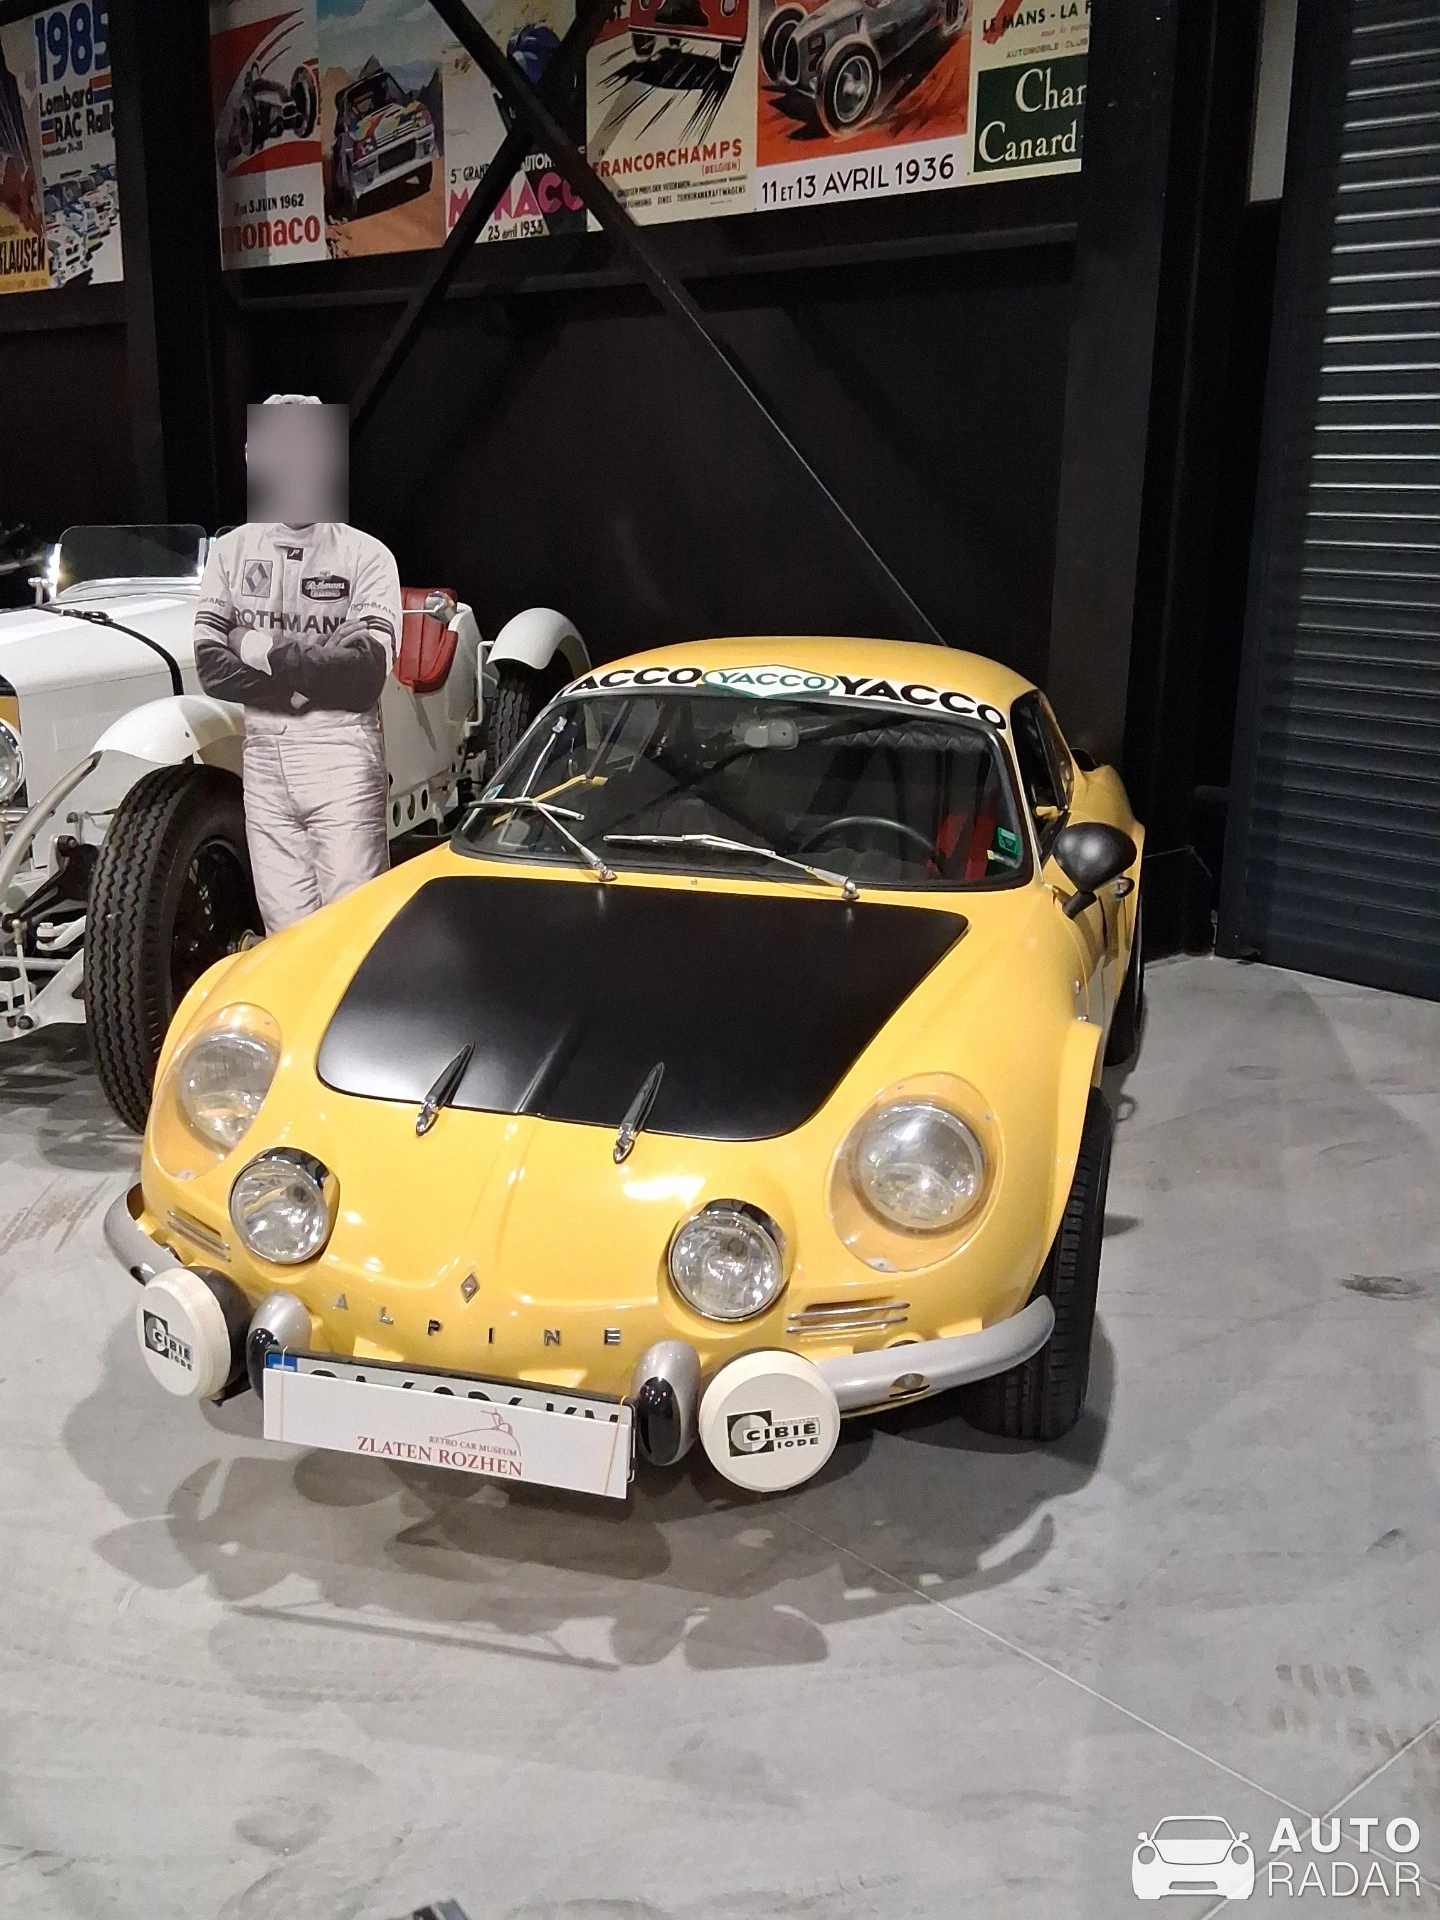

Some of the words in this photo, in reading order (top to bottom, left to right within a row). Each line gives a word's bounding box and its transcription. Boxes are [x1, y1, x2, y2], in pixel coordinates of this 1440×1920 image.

[983, 17, 997, 34] LE
[1002, 8, 1046, 29] MANS
[1060, 2, 1079, 19] LA
[35, 0, 109, 85] 1985
[40, 80, 93, 117] Lombard
[1015, 67, 1087, 112] Char
[55, 112, 83, 142] RAC
[979, 119, 1077, 163] Canard
[592, 138, 742, 178] FRANCORCHAMPS
[796, 175, 816, 200] 13
[822, 165, 889, 196] AVRIL
[895, 154, 954, 185] 1936
[255, 197, 277, 212] JUIN
[280, 193, 304, 209] 1962
[488, 225, 500, 241] 23
[234, 606, 347, 635] ROTHMAN
[560, 667, 703, 696] ACCO
[718, 672, 827, 690] YACCO
[835, 675, 1007, 730] YACCO
[332, 1292, 621, 1347] ALPINE
[357, 1436, 432, 1461] ZLATEN
[439, 1448, 522, 1476] ROZHEN
[429, 1436, 457, 1448] RETRO
[460, 1441, 477, 1449] CAR
[479, 1444, 517, 1457] MUSEUM
[777, 1437, 819, 1449] IODE
